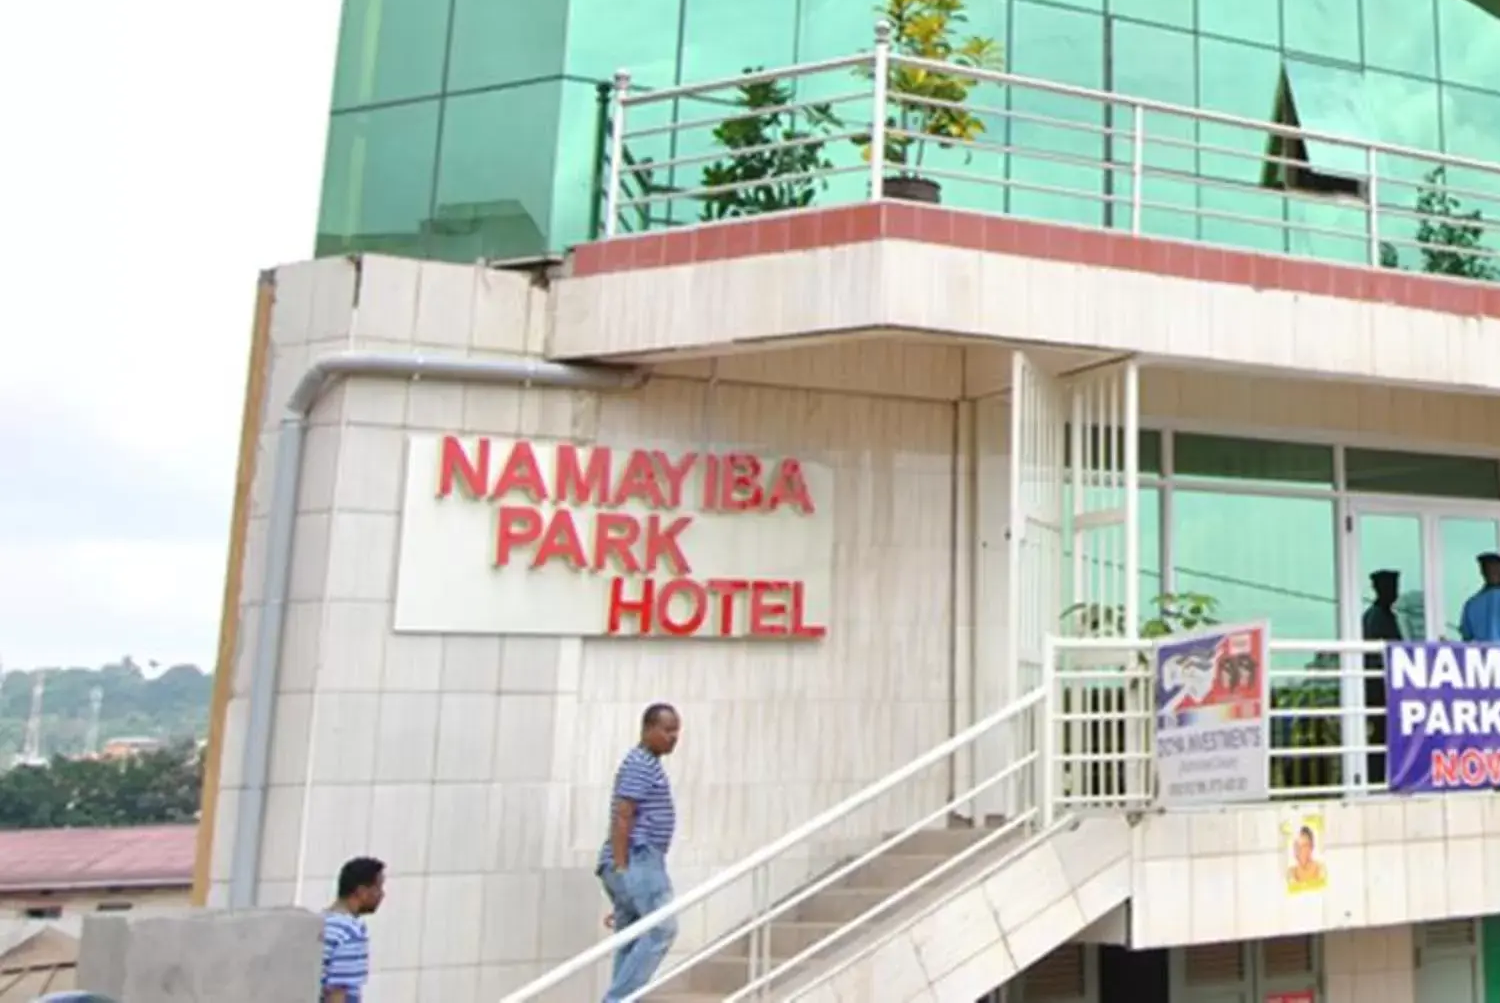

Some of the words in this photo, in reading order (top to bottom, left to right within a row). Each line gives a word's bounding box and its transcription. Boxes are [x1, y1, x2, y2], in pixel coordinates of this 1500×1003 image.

[436, 435, 815, 514] NAMAYIBA
[494, 505, 694, 574] PARK
[607, 576, 828, 639] HOTEL
